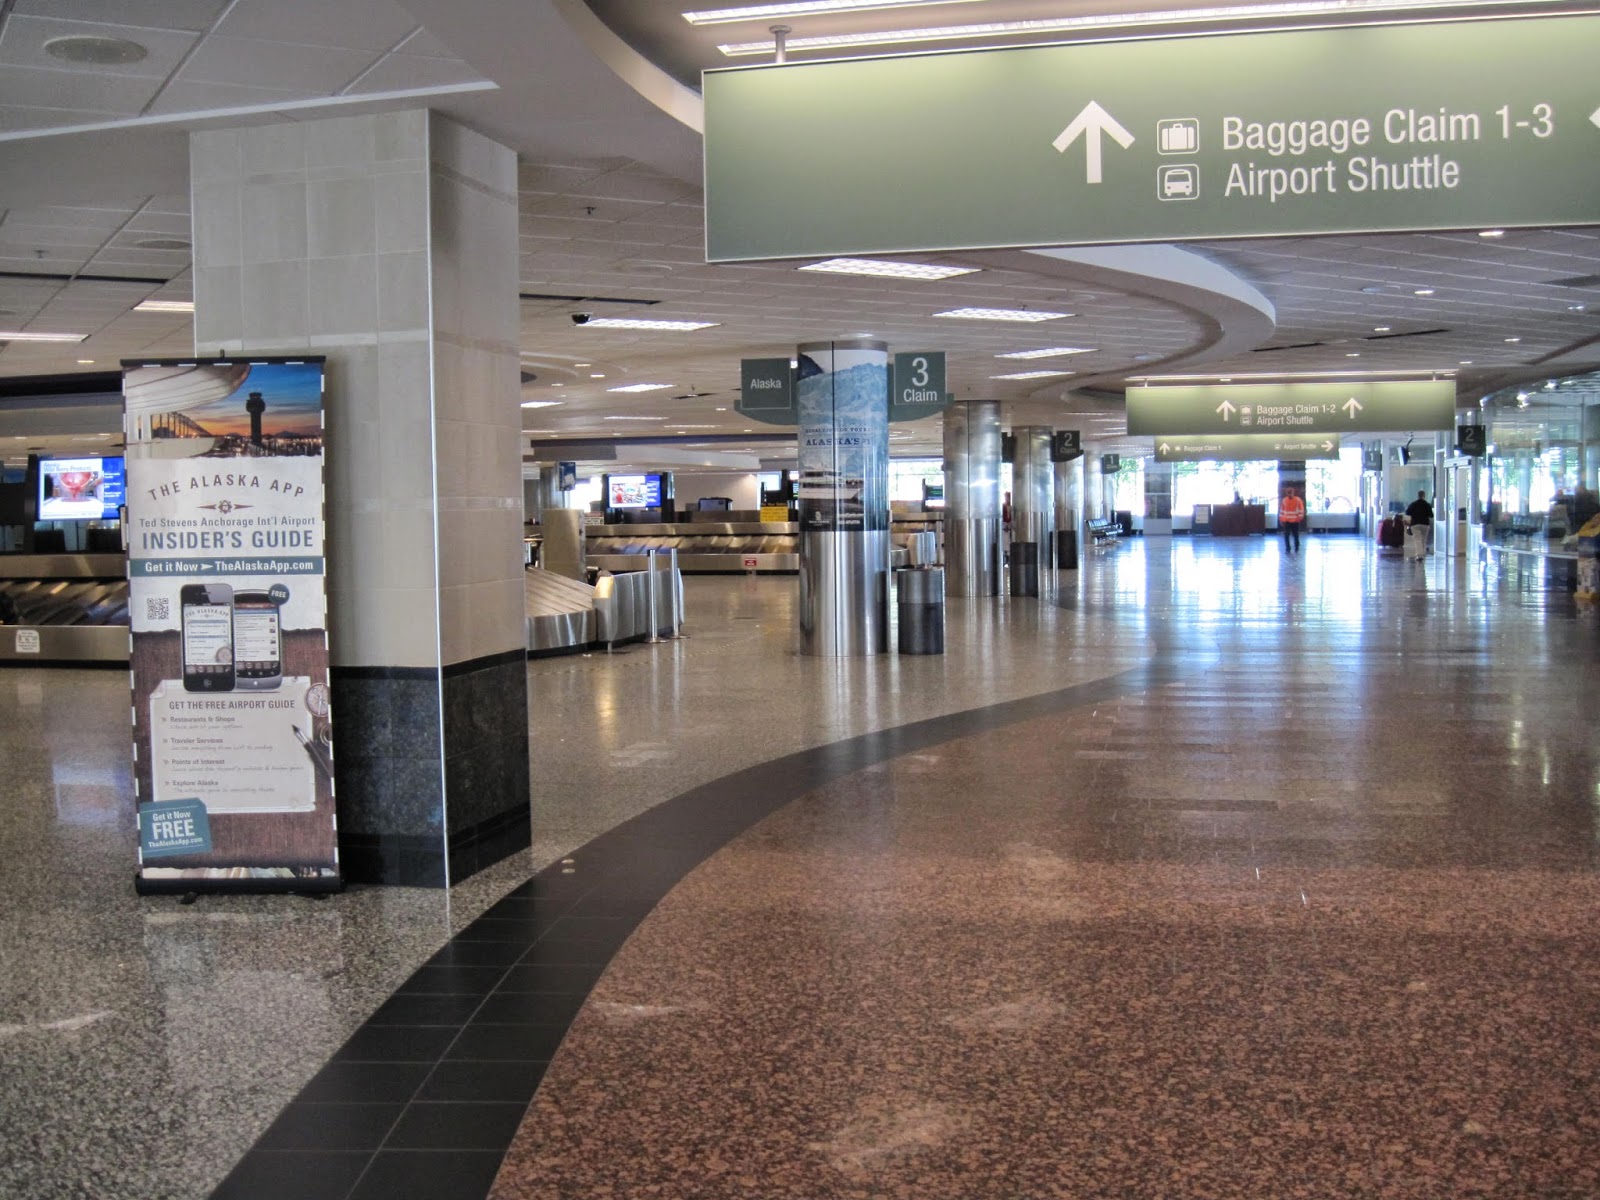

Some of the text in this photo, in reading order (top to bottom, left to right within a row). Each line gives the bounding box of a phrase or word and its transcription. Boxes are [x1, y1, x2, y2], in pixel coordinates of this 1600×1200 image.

[1222, 103, 1554, 156] Baggage Claim 1-3
[1224, 154, 1459, 202] Airport Shuttle
[911, 357, 929, 387] 3
[750, 378, 782, 389] Alaska
[903, 388, 938, 403] Claim
[1256, 404, 1336, 415] Baggage Claim 1-2
[1256, 415, 1314, 426] Airport Shuttle
[1064, 433, 1073, 447] 2
[1465, 427, 1475, 442] 2
[1109, 455, 1114, 464] 1
[148, 474, 304, 500] THE ALASKA APP
[139, 516, 316, 528] Ted Stevens Anchorage Int'l Airport
[142, 530, 313, 550] INSIDER'S GUIDE
[145, 560, 314, 573] Get it Now TheAlaskaApp.com
[270, 590, 287, 598] FREE
[169, 699, 296, 710] GET THE FREE AIRPORT GUIDE
[152, 813, 166, 821] Get
[152, 819, 195, 840] FREE
[148, 837, 203, 848] TheAlaskaApp.com
